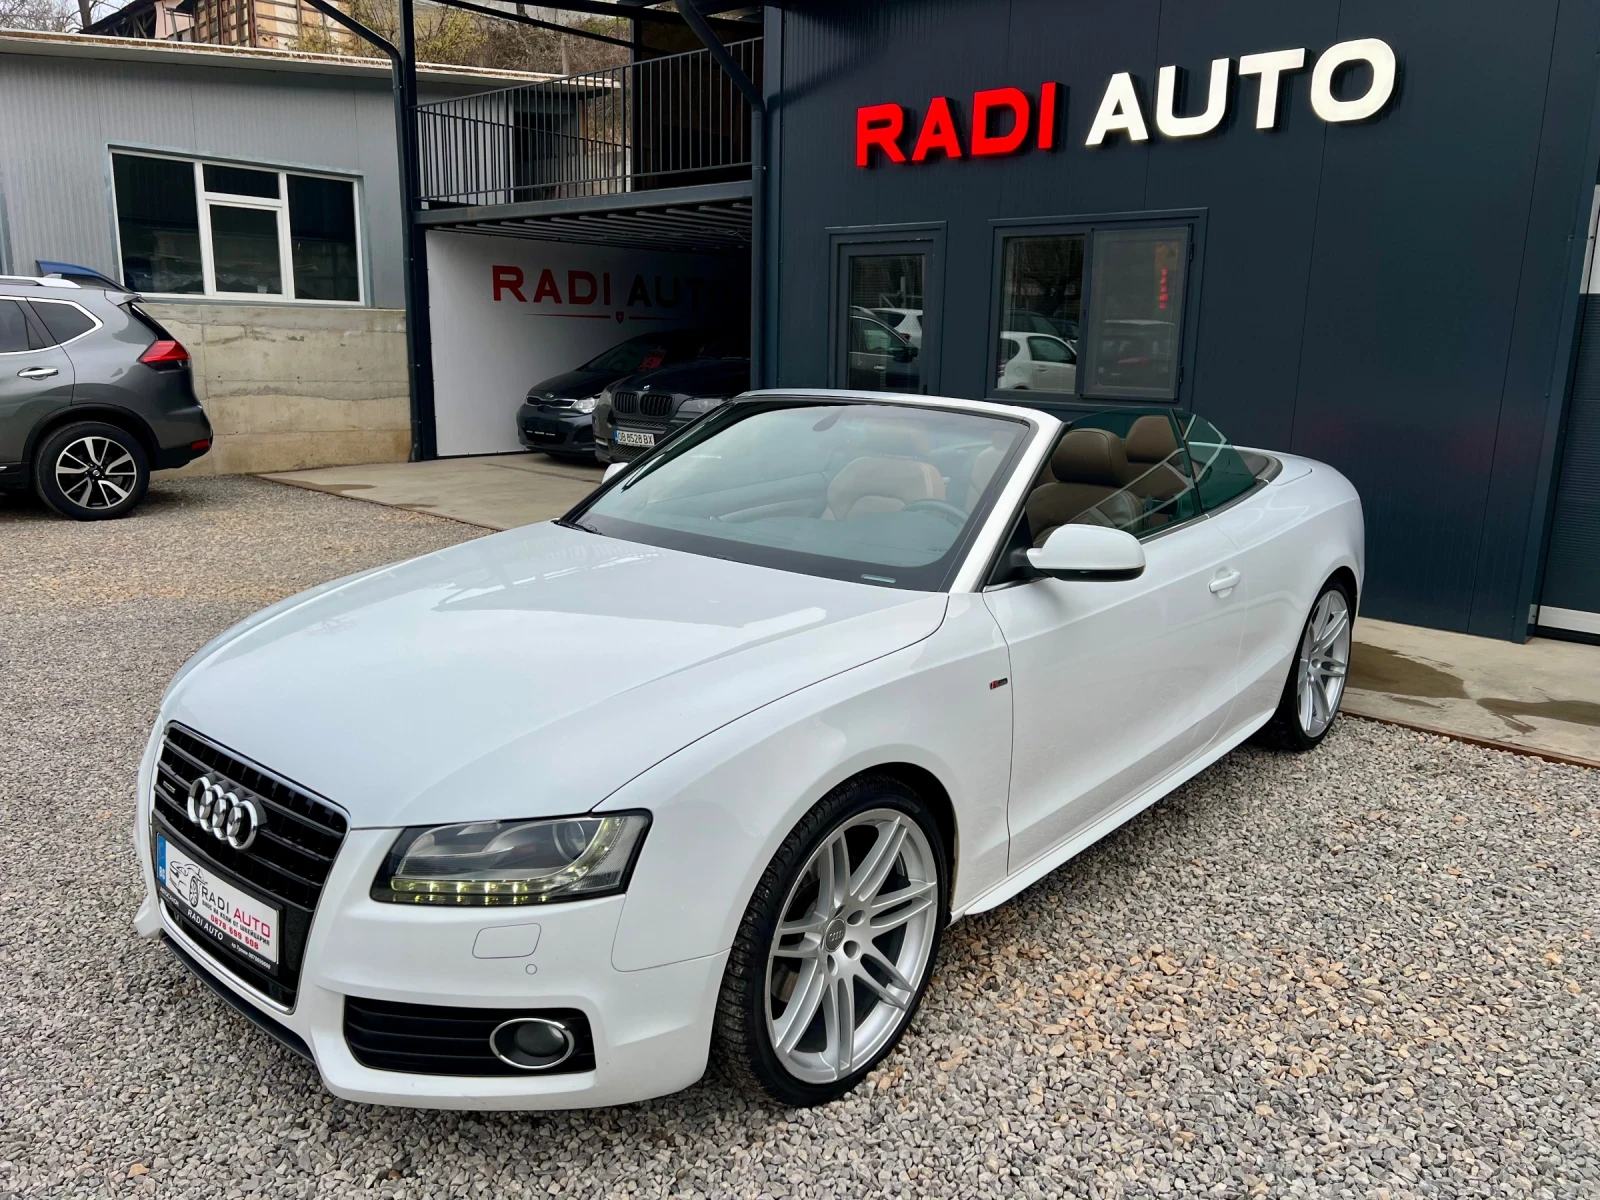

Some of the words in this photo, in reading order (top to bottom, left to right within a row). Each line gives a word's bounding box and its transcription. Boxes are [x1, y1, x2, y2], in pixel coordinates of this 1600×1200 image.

[856, 81, 1059, 167] RADI
[1085, 38, 1397, 146] AUTO
[492, 264, 611, 306] RADI
[643, 434, 653, 445] BX
[187, 909, 203, 926] RADI
[204, 923, 224, 941] AUTO
[201, 885, 230, 914] RADI
[233, 907, 271, 938] AUTO
[210, 914, 227, 931] 0878
[245, 936, 259, 950] 608
[239, 923, 270, 947] ШВЕЙЦАРИЯ
